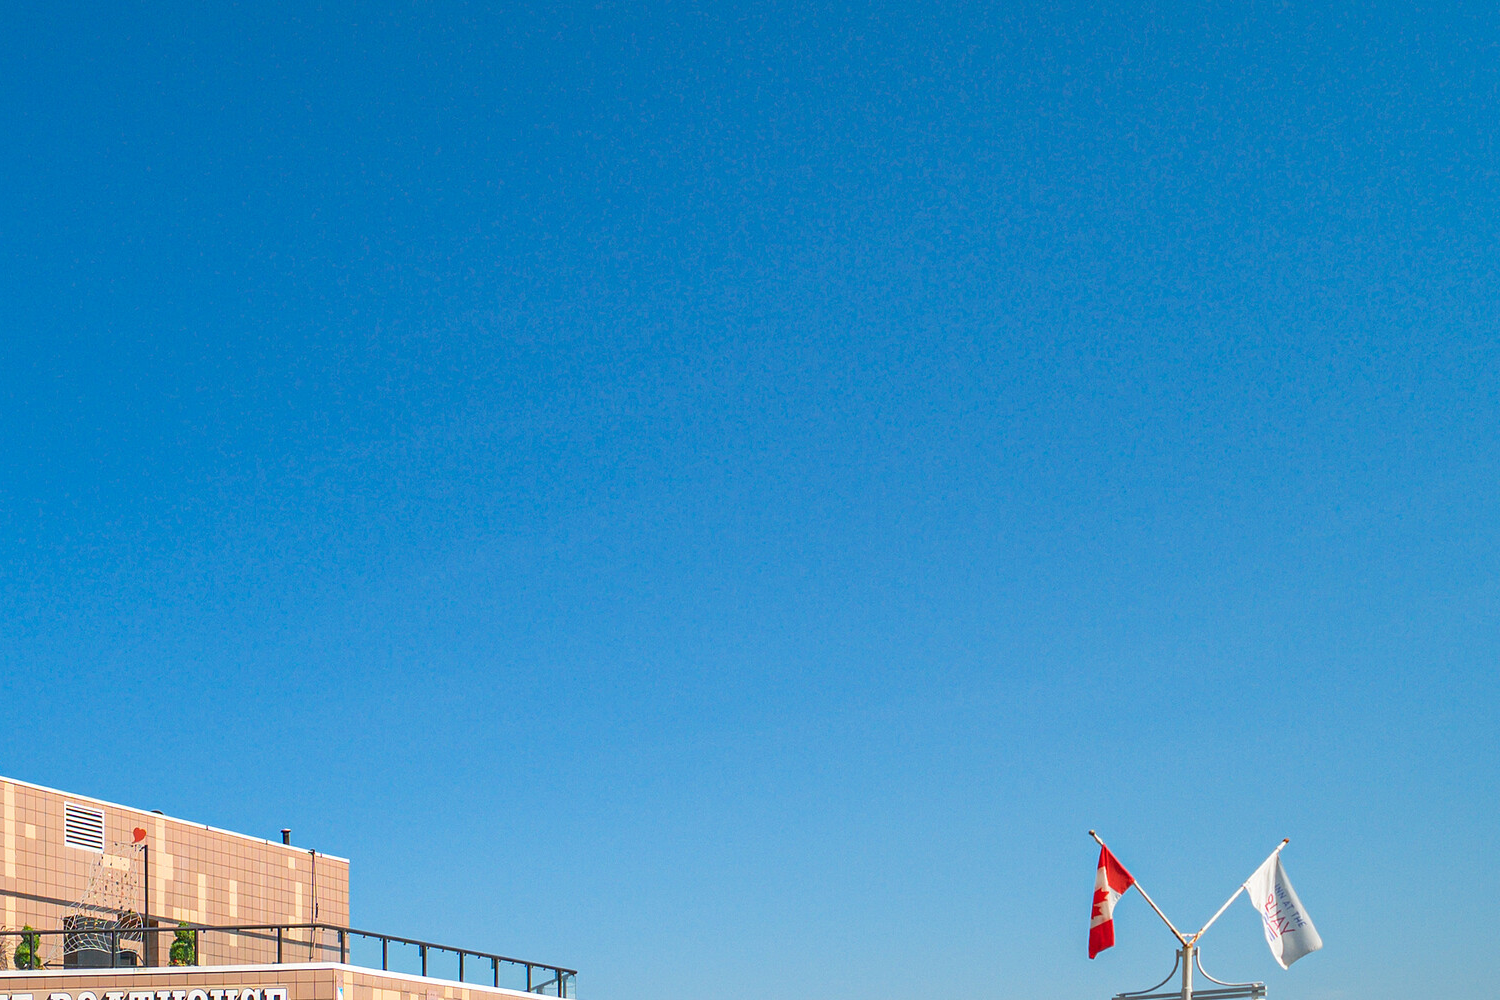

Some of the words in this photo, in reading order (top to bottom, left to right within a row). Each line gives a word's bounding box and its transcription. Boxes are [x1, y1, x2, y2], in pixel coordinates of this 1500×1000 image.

[1275, 884, 1286, 899] INN
[1283, 901, 1295, 910] AT
[1291, 911, 1307, 928] THE
